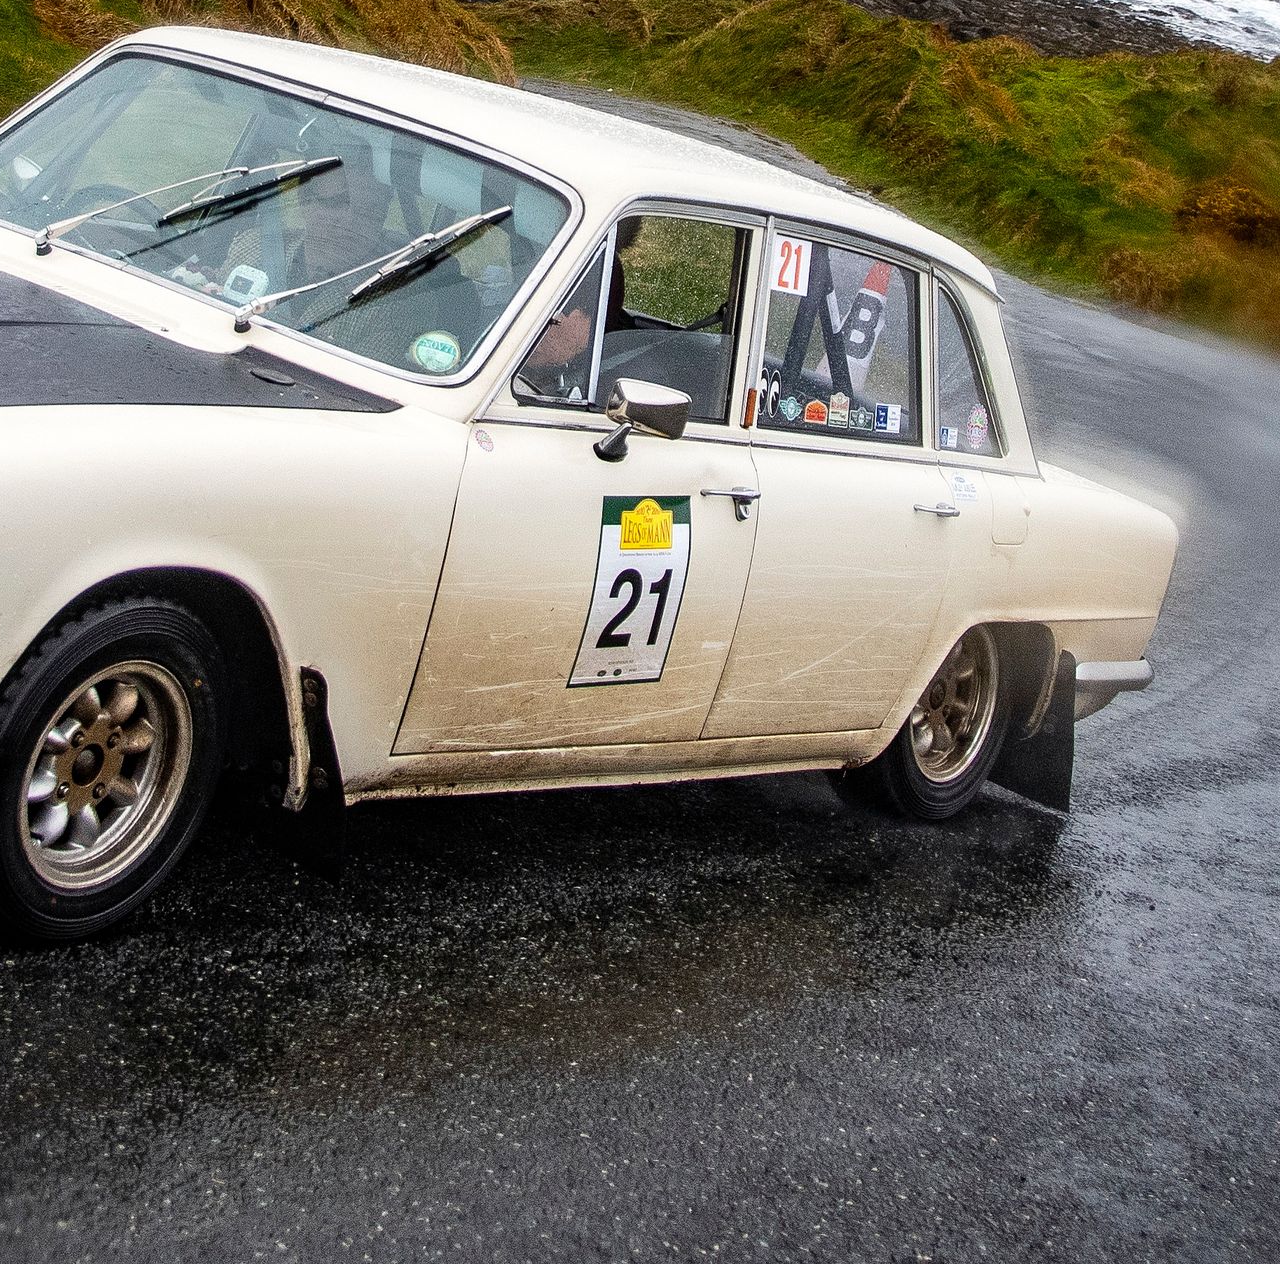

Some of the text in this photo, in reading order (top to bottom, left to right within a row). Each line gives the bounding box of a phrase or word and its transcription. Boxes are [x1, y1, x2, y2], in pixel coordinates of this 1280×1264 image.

[777, 240, 803, 290] 21
[840, 292, 883, 360] B
[623, 516, 642, 544] LEGS
[647, 515, 671, 544] MANN
[595, 568, 674, 649] 21
